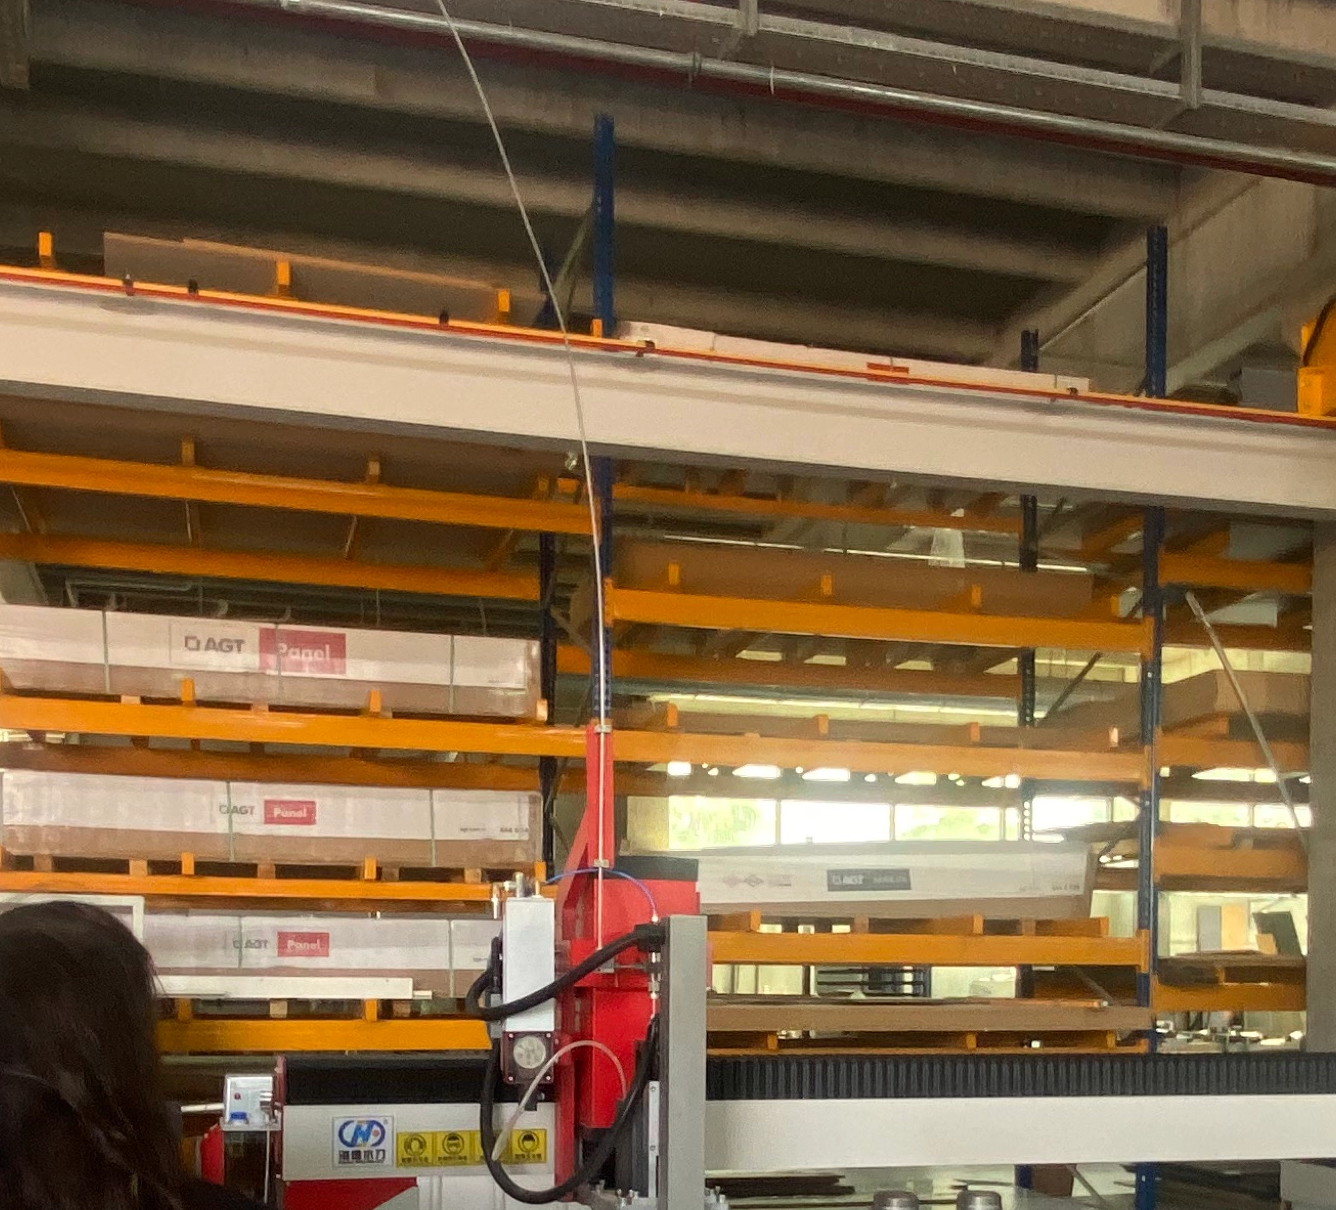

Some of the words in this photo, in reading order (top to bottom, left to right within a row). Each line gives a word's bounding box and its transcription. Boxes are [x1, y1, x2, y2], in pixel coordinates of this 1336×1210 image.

[203, 637, 245, 654] AGT
[277, 643, 332, 663] Panel
[273, 806, 308, 819] Panel
[287, 939, 322, 951] Panel
